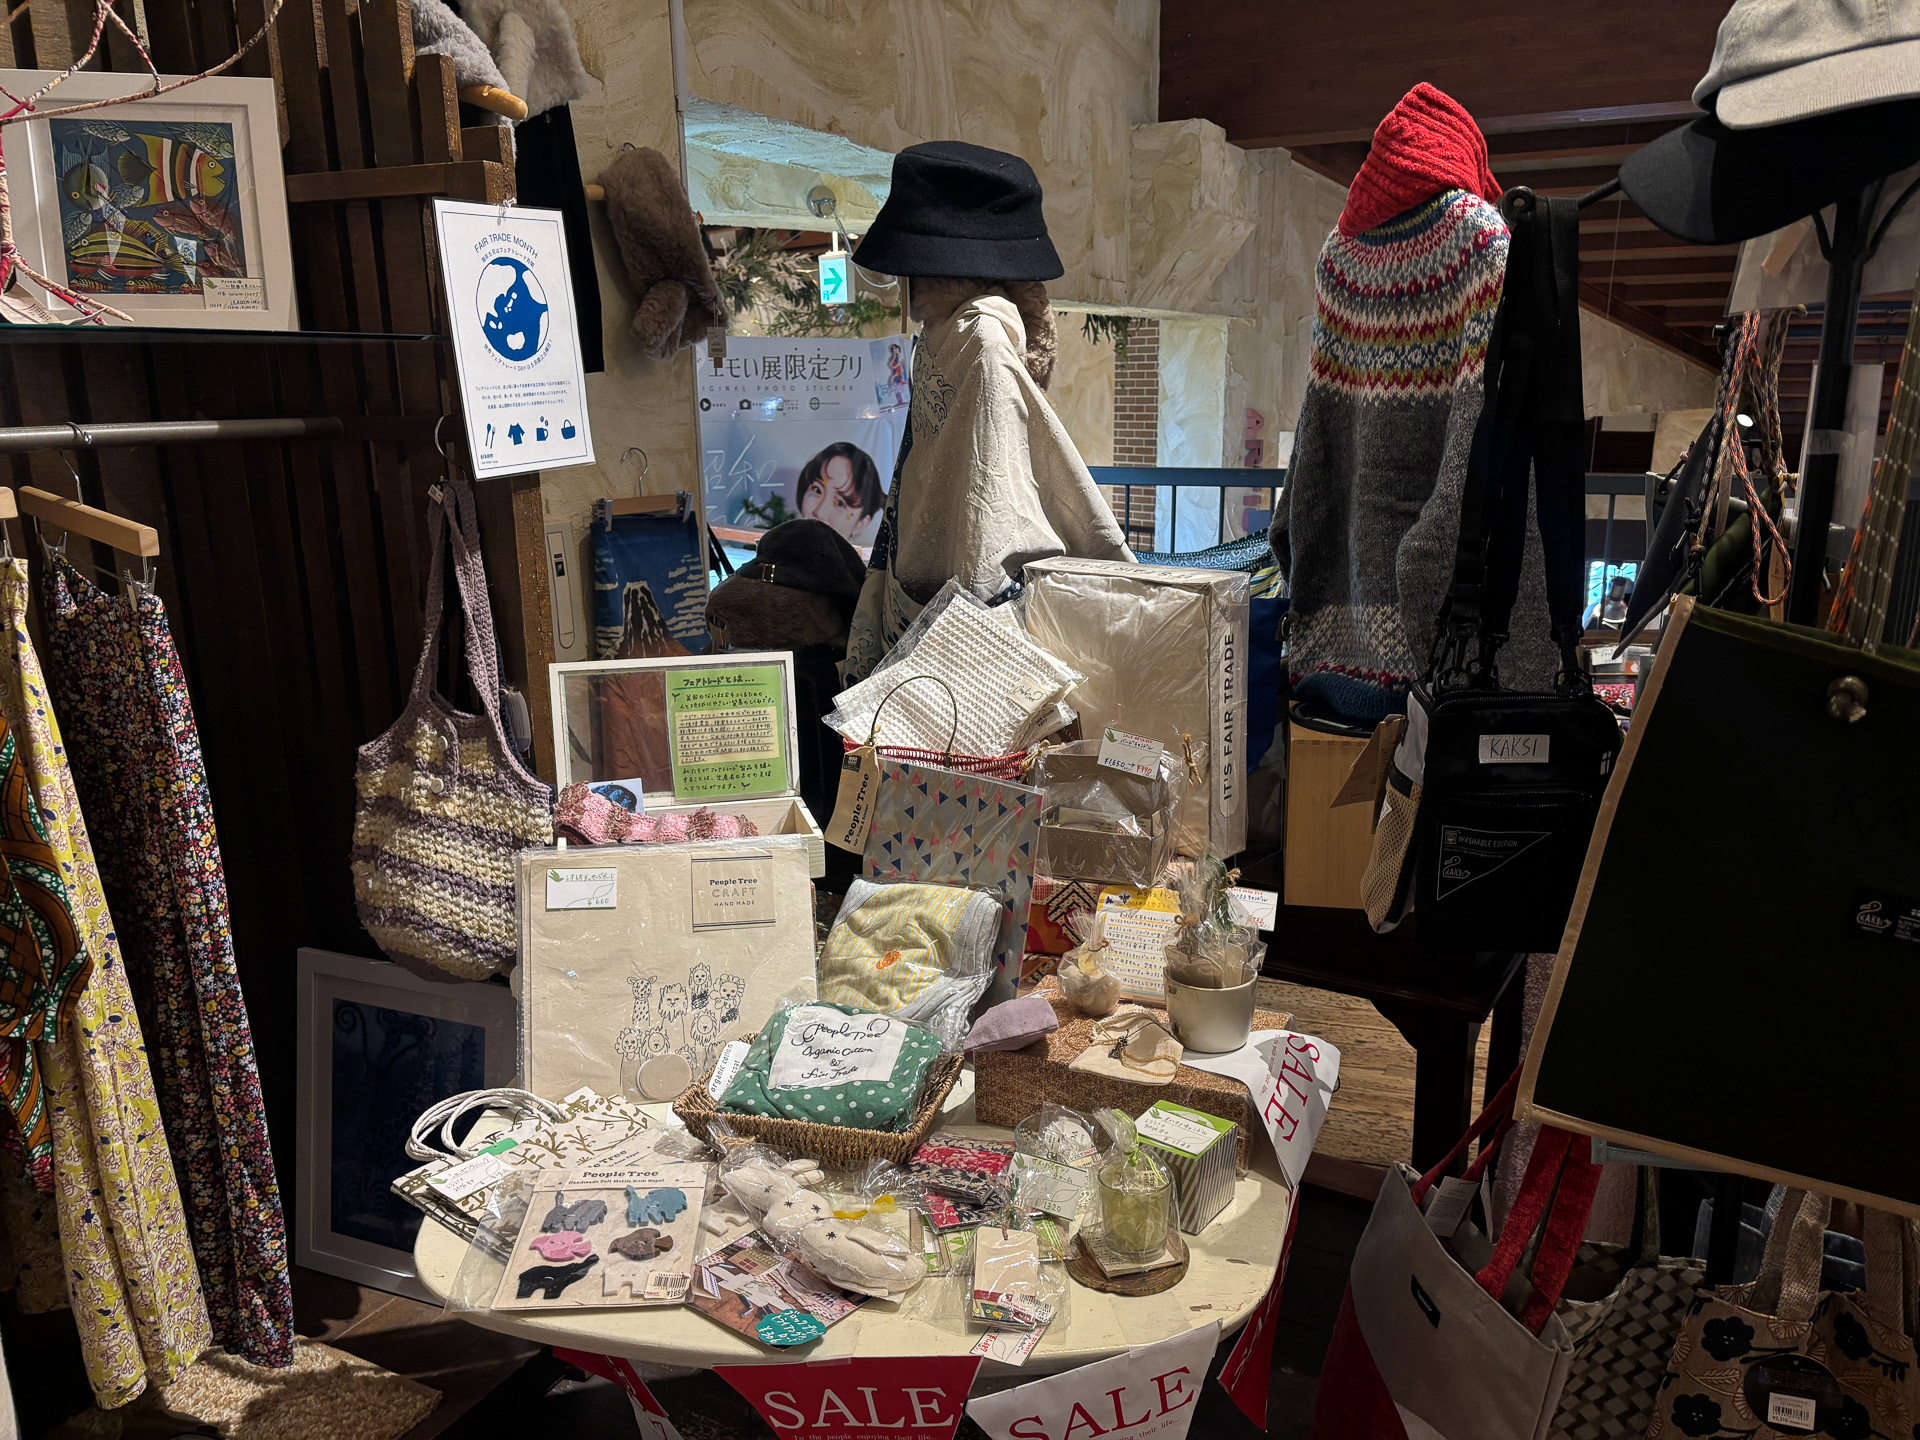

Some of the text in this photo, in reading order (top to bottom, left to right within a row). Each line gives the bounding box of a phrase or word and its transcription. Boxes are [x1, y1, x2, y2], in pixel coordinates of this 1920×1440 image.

[474, 233, 538, 259] FAIR TRADE MONTH
[708, 353, 862, 381] エモい展限定プリ
[1223, 632, 1234, 800] IT'S FAIR TRADE
[1490, 738, 1537, 759] KAKSI
[844, 773, 870, 844] People Tree
[1458, 835, 1519, 848] WASHABLE EDITION
[709, 878, 737, 886] People
[712, 887, 757, 898] CRAFT
[791, 1023, 850, 1046] People
[711, 1044, 733, 1093] organic cotton
[732, 1060, 741, 1077] coat
[1264, 1033, 1320, 1142] SALE
[598, 1150, 627, 1164] Tree
[583, 1171, 625, 1179] People
[764, 1386, 954, 1430] SALE
[1009, 1366, 1194, 1440] SALE
[1139, 1426, 1157, 1439] their
